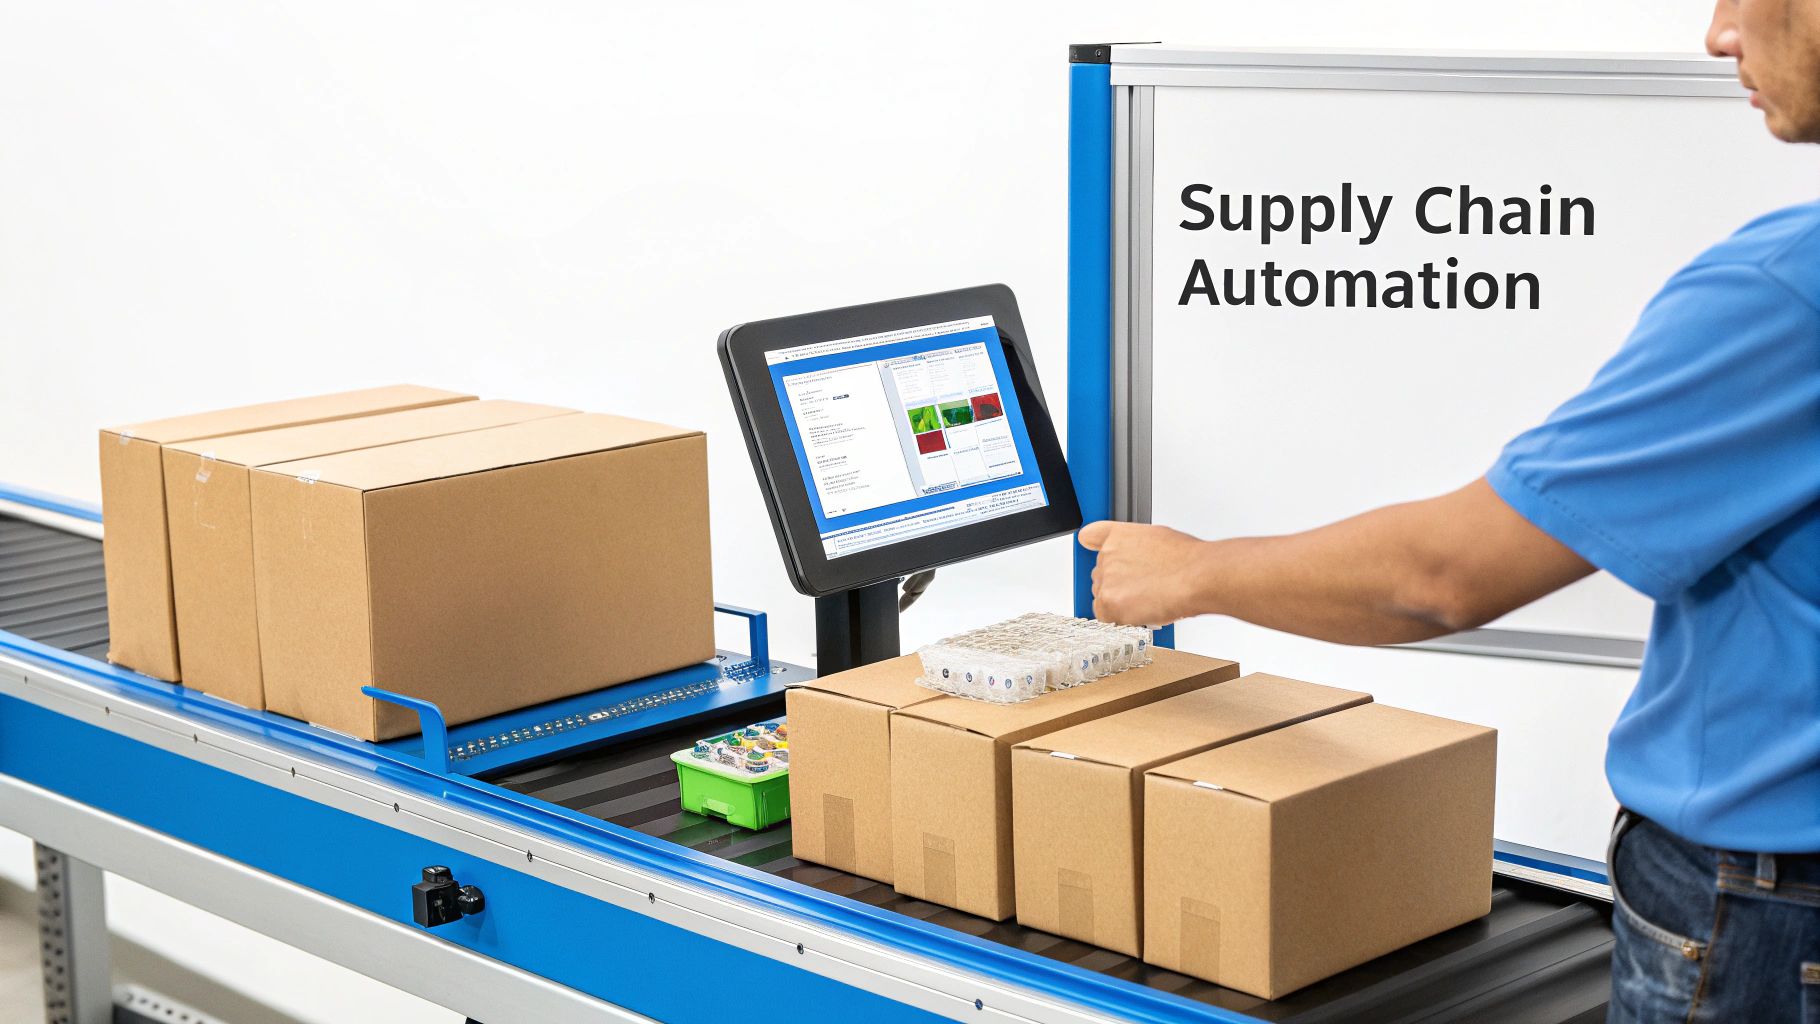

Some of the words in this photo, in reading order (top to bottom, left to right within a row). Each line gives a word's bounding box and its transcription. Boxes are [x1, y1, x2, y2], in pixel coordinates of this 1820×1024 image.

[1179, 182, 1394, 246] Supply
[1415, 183, 1595, 236] Chain
[1177, 256, 1540, 310] Automation
